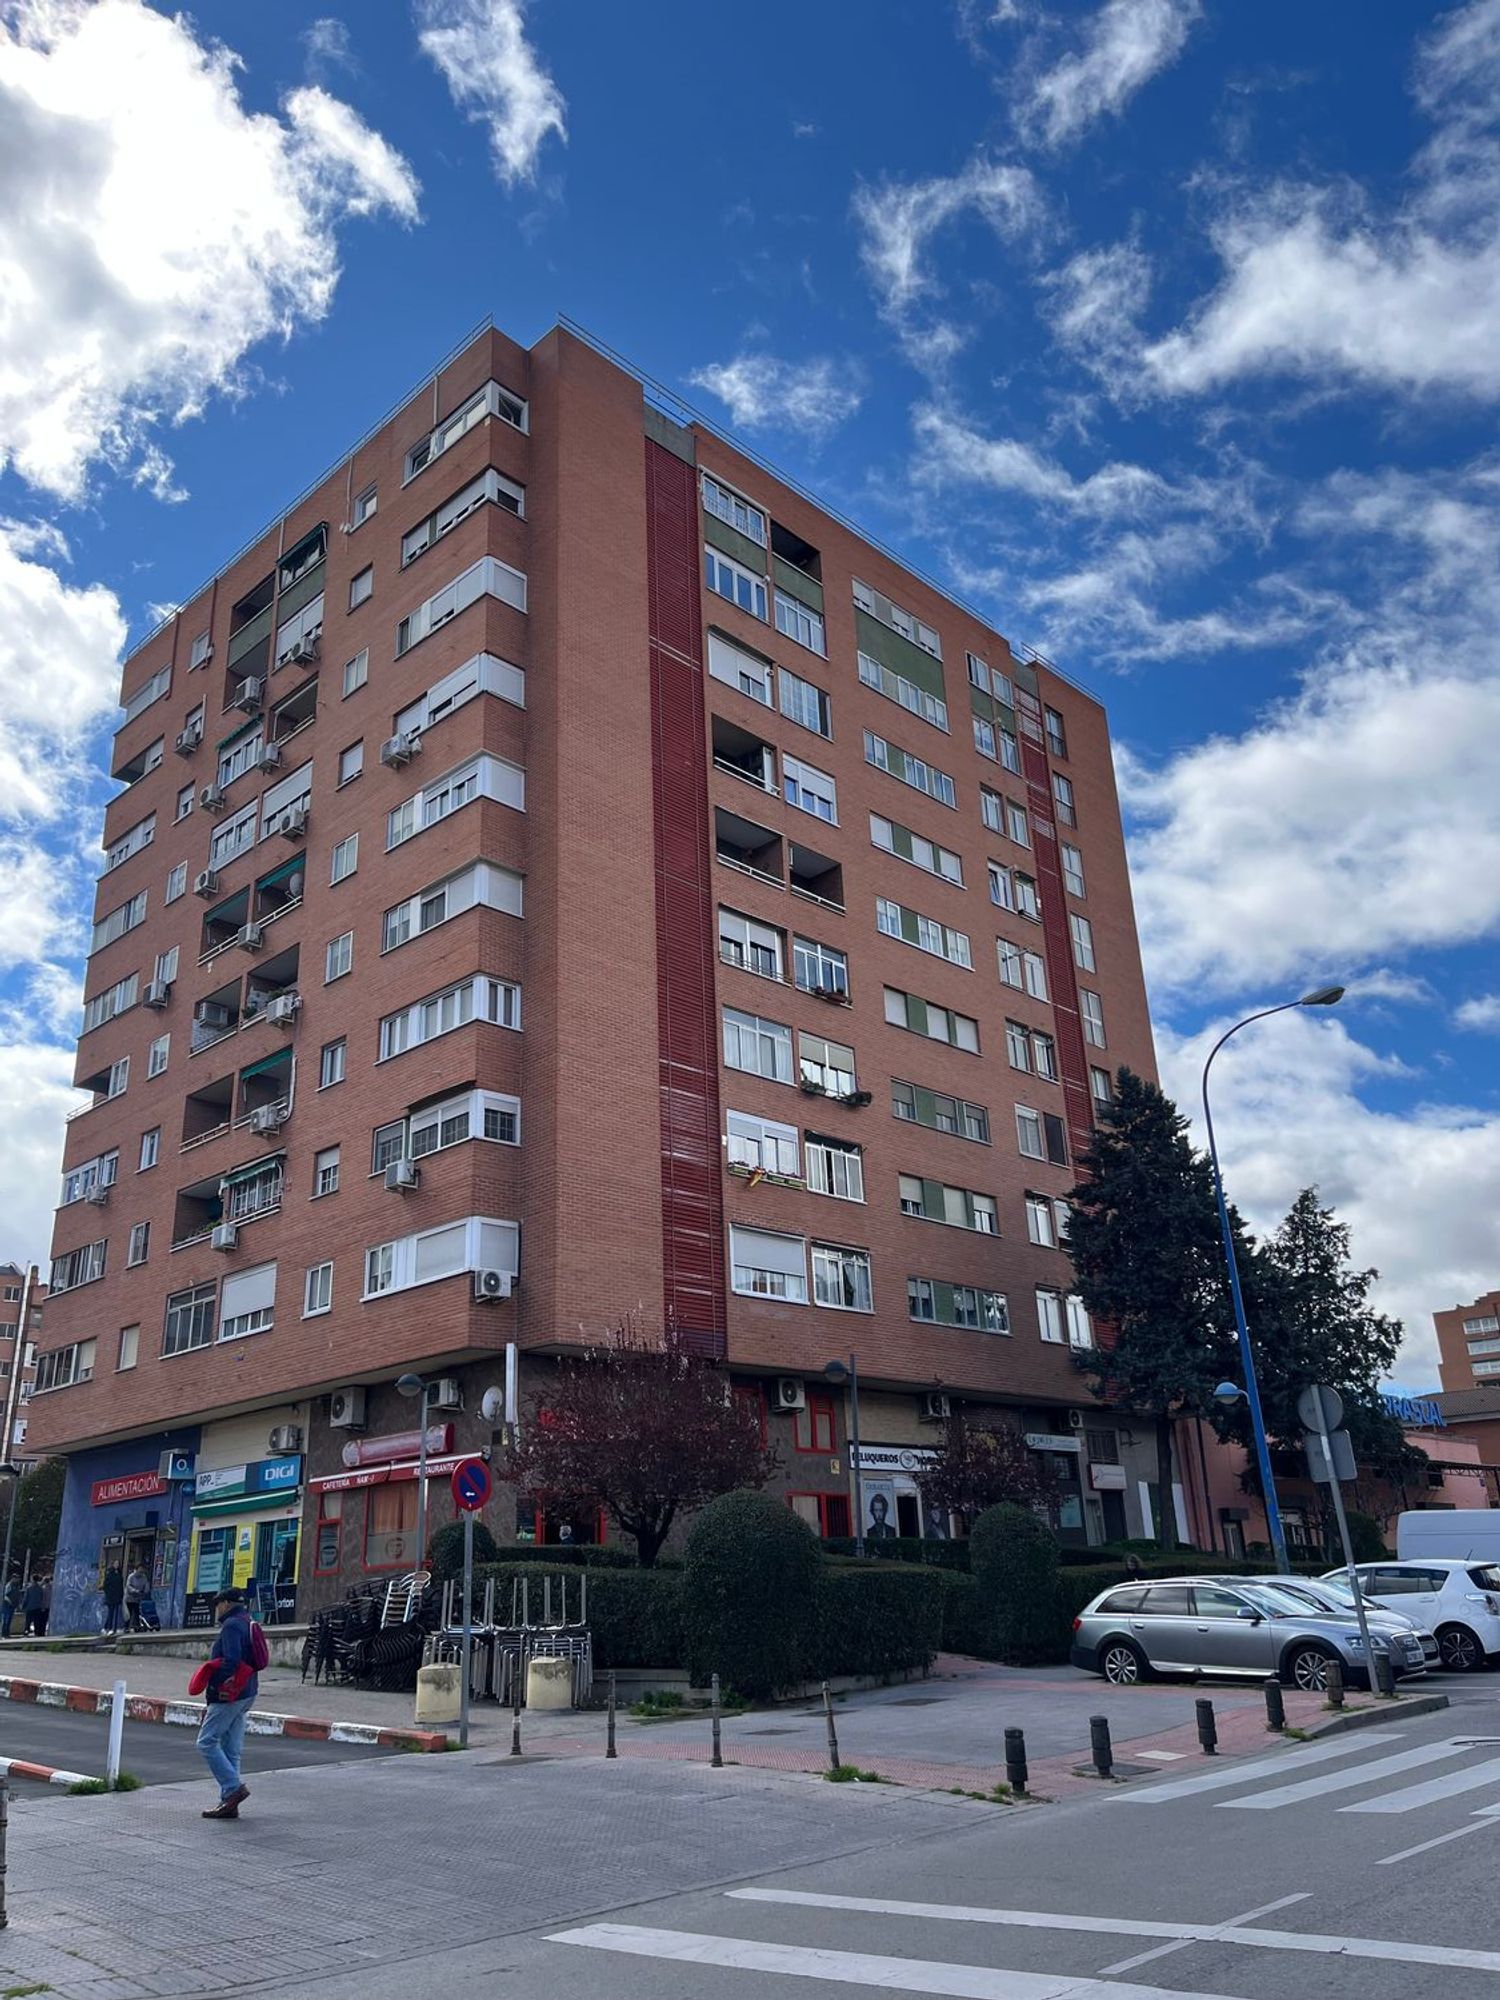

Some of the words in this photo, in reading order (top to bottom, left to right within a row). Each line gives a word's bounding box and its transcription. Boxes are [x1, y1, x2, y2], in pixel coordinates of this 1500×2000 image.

[264, 1464, 295, 1481] DIGI
[413, 1462, 455, 1476] RETAURANTE
[97, 1473, 160, 1501] ALIMENTACIÓN
